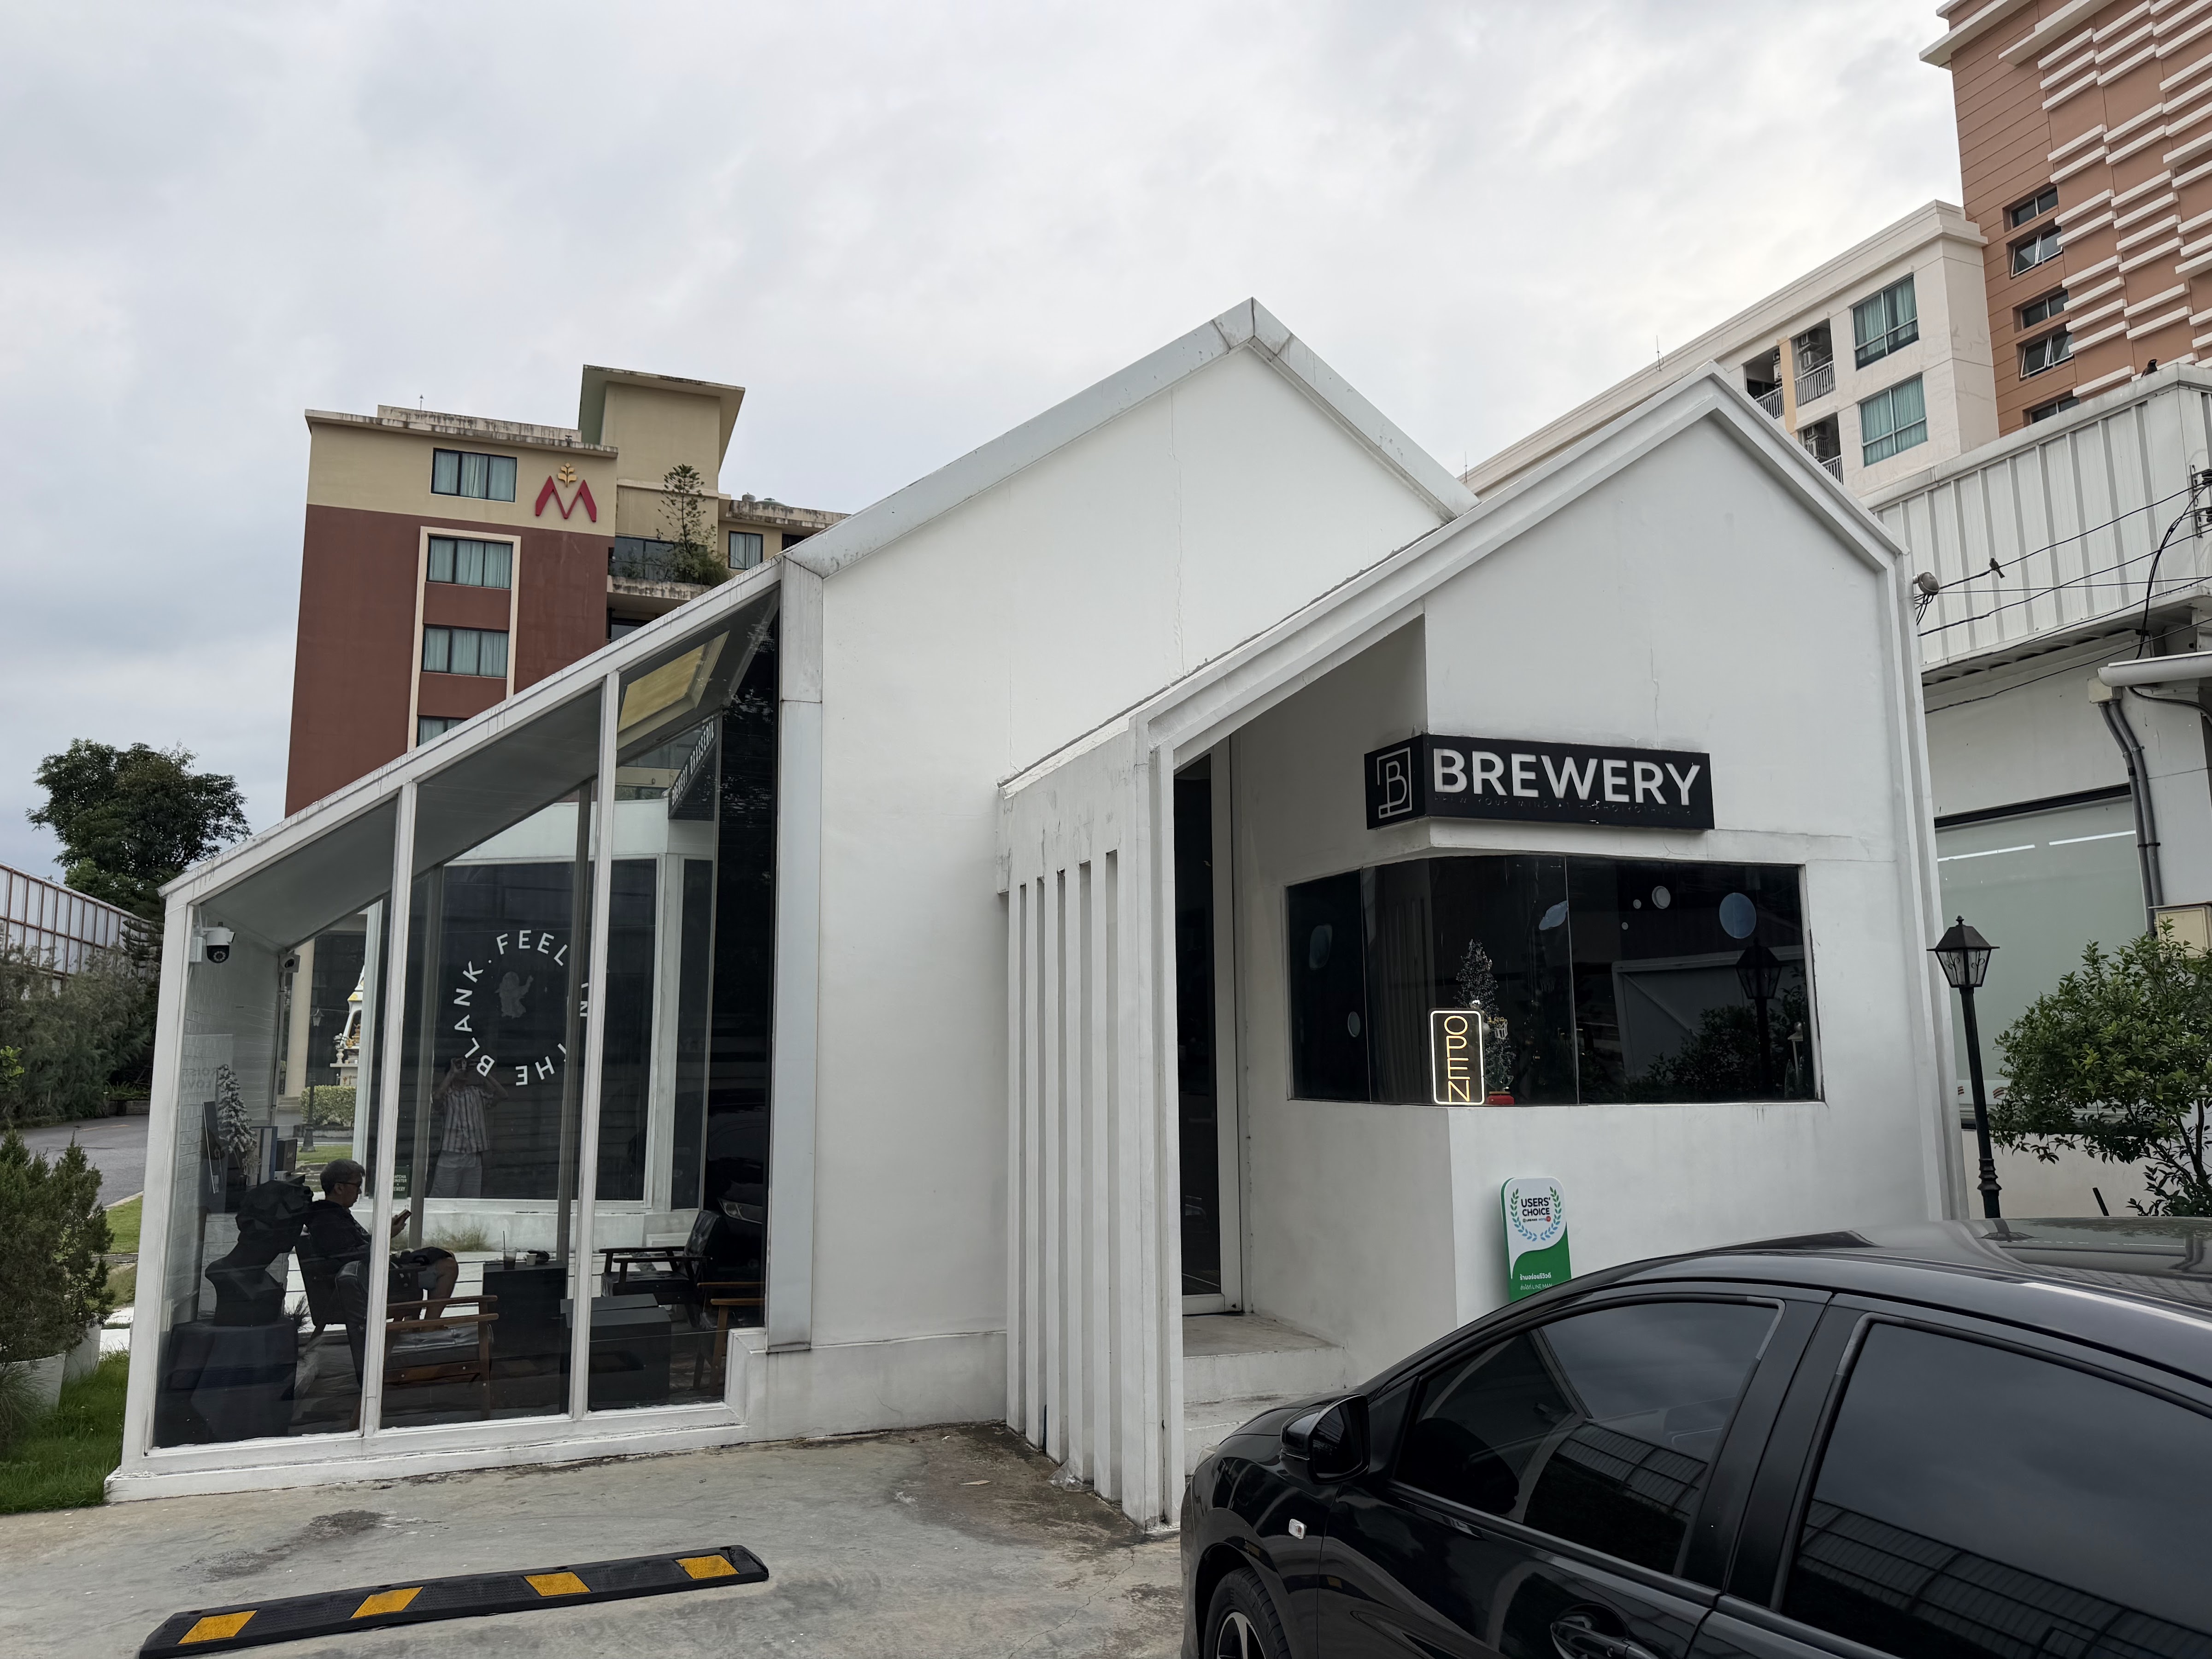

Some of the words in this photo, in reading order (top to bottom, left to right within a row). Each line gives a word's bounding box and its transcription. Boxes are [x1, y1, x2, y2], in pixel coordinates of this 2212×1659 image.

[1433, 748, 1700, 806] BREWERY
[496, 930, 568, 966] FEEL
[515, 1043, 566, 1086] HE
[1444, 1015, 1471, 1102] OPEN
[1522, 1208, 1550, 1217] CHOICE
